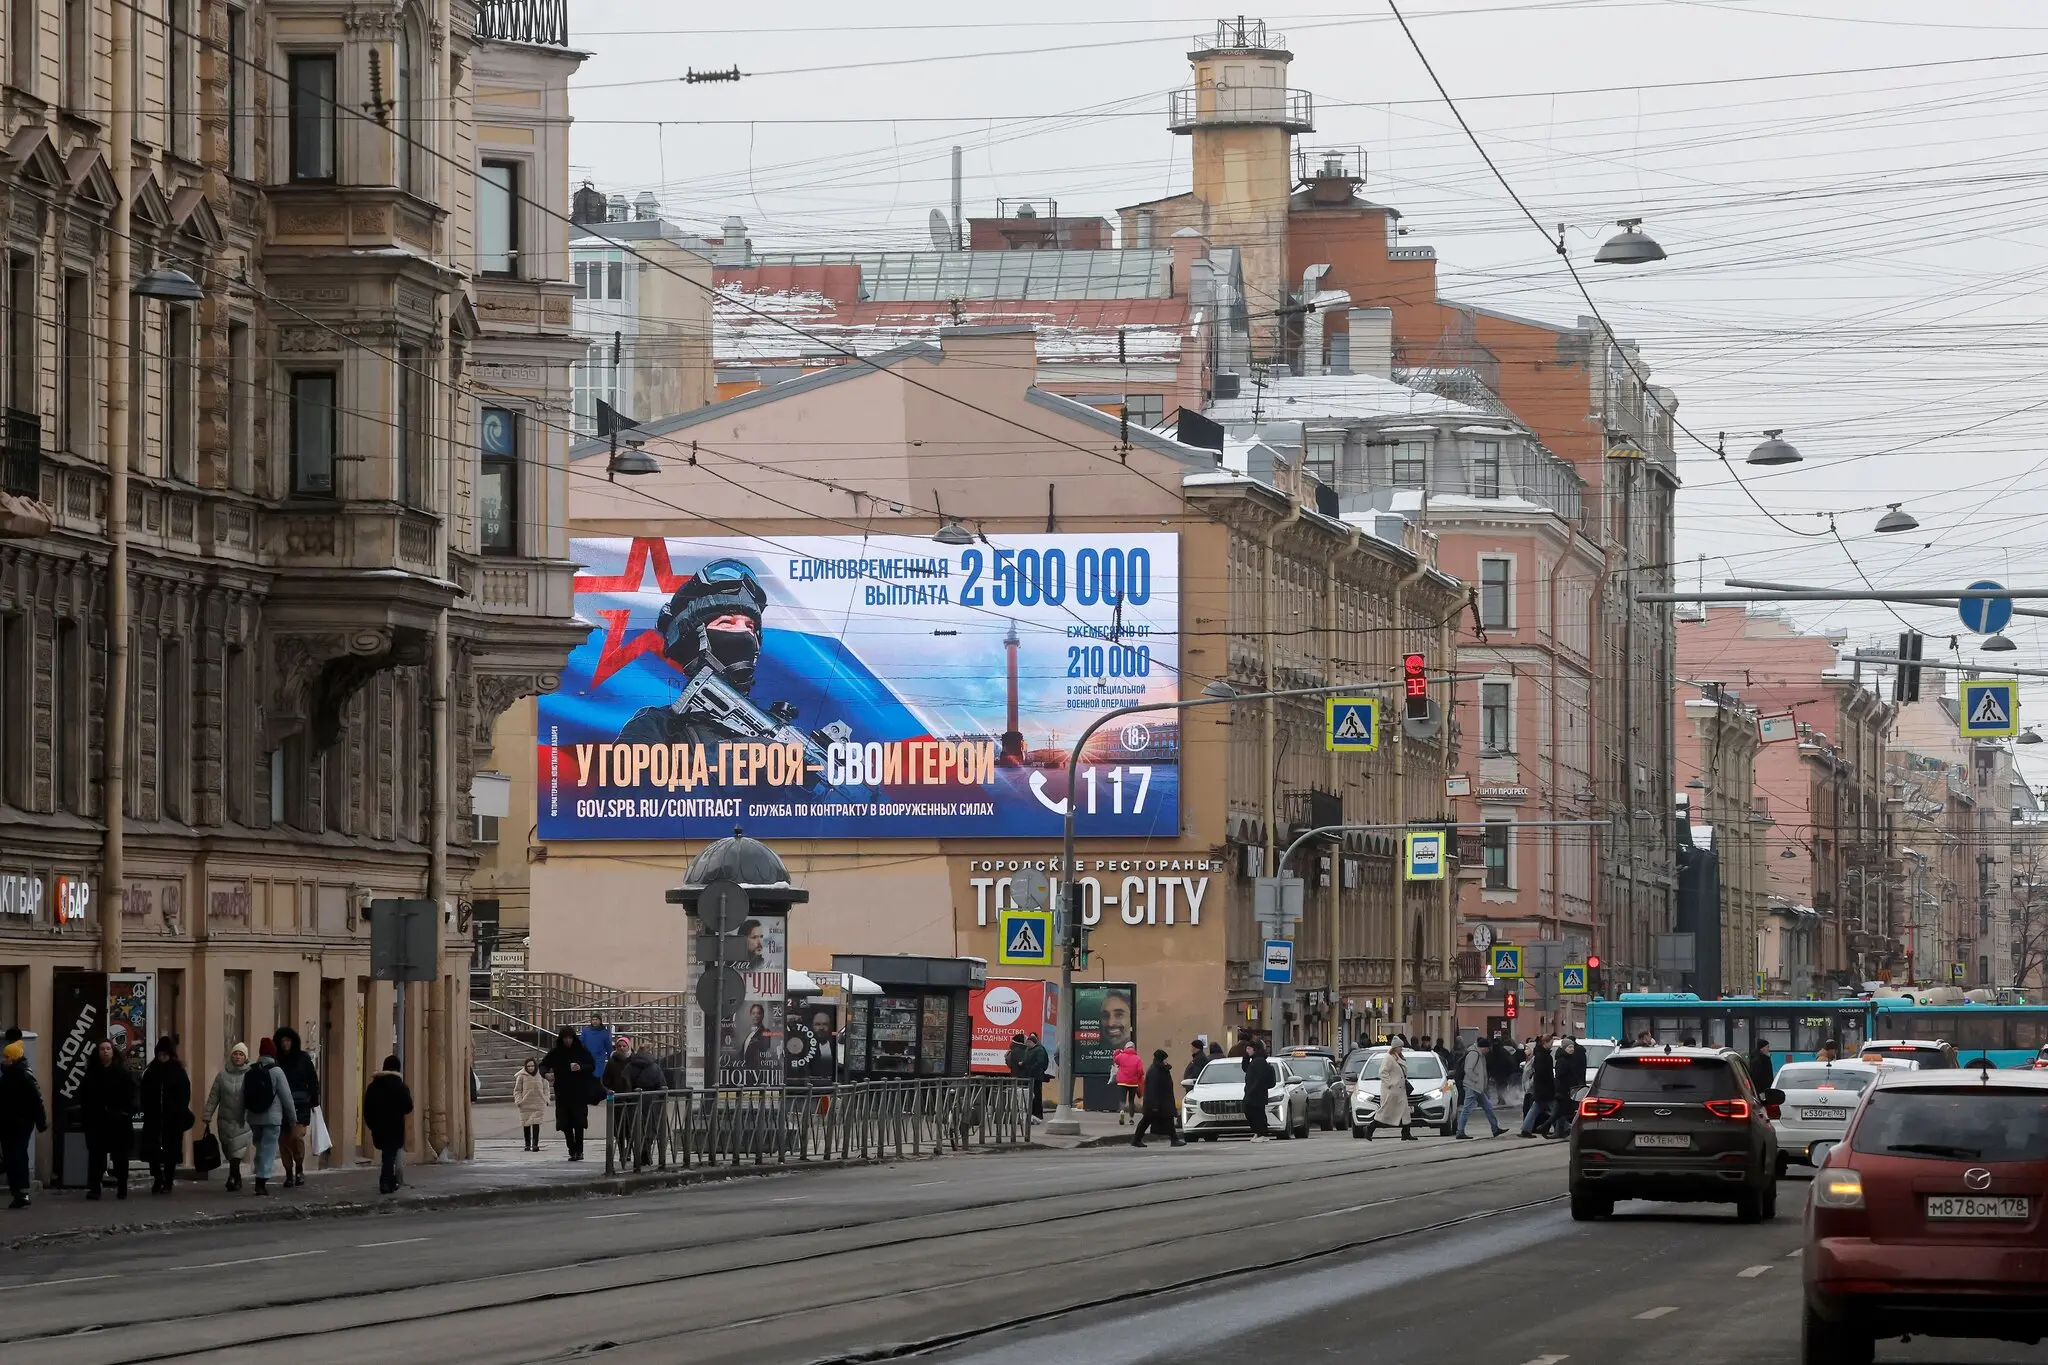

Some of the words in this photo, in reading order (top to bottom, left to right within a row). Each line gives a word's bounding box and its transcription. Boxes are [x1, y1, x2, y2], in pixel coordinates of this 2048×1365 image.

[488, 523, 499, 534] 59
[790, 558, 949, 582] ЕДИНОВРЕМЕННАЯ
[960, 548, 984, 606] 2
[992, 548, 1066, 606] 500
[1076, 547, 1150, 606] 000
[866, 584, 949, 606] ВЫПЛАТА
[1067, 625, 1135, 638] ЕЖЕМЕСЯНО
[1138, 625, 1150, 638] ОТ
[1068, 645, 1104, 678] 210
[1109, 645, 1150, 678] 000
[1067, 686, 1072, 694] В
[1074, 685, 1092, 694] ЗОНЕ
[1093, 684, 1146, 695] СПЕЦИАЛЬНОЙ
[1408, 678, 1425, 696] 32
[1067, 698, 1100, 708] ВОЕННОЙ
[1102, 698, 1139, 709] ОПЕРАЦИИ
[1126, 728, 1146, 746] 18+
[576, 743, 594, 787] У
[600, 742, 804, 792] ГОРОДА-ГЕРОЯ
[827, 742, 902, 786] СВОИ
[909, 742, 995, 785] ГЕРОИ
[1082, 766, 1152, 814] 117
[577, 798, 742, 818] GOV.SPB.RU/CONTRACT
[748, 803, 792, 818] СЛУЖБА
[794, 804, 808, 817] ПО
[810, 803, 868, 817] КОНТРАКТУ
[870, 803, 876, 816] В
[879, 803, 958, 816] ВООРУЖЕННЫХ
[959, 802, 994, 816] СИЛАХ
[970, 858, 1084, 871] ГОРОДСКЕ
[1096, 860, 1210, 871] РЕСТОРАНЫ
[0, 876, 16, 913] КТ
[20, 877, 42, 915] БАР
[68, 882, 90, 919] БАР
[768, 940, 776, 954] 13
[986, 1004, 1018, 1014] Sunmar
[56, 1003, 97, 1071] КОМП
[977, 1027, 1024, 1035] ТУРАГЕНТСТВО
[791, 1024, 818, 1068] ТРОФИМОВ
[720, 1053, 746, 1068] Олег
[1932, 1199, 1997, 1215] М878ОМ
[2000, 1199, 2024, 1211] 178
